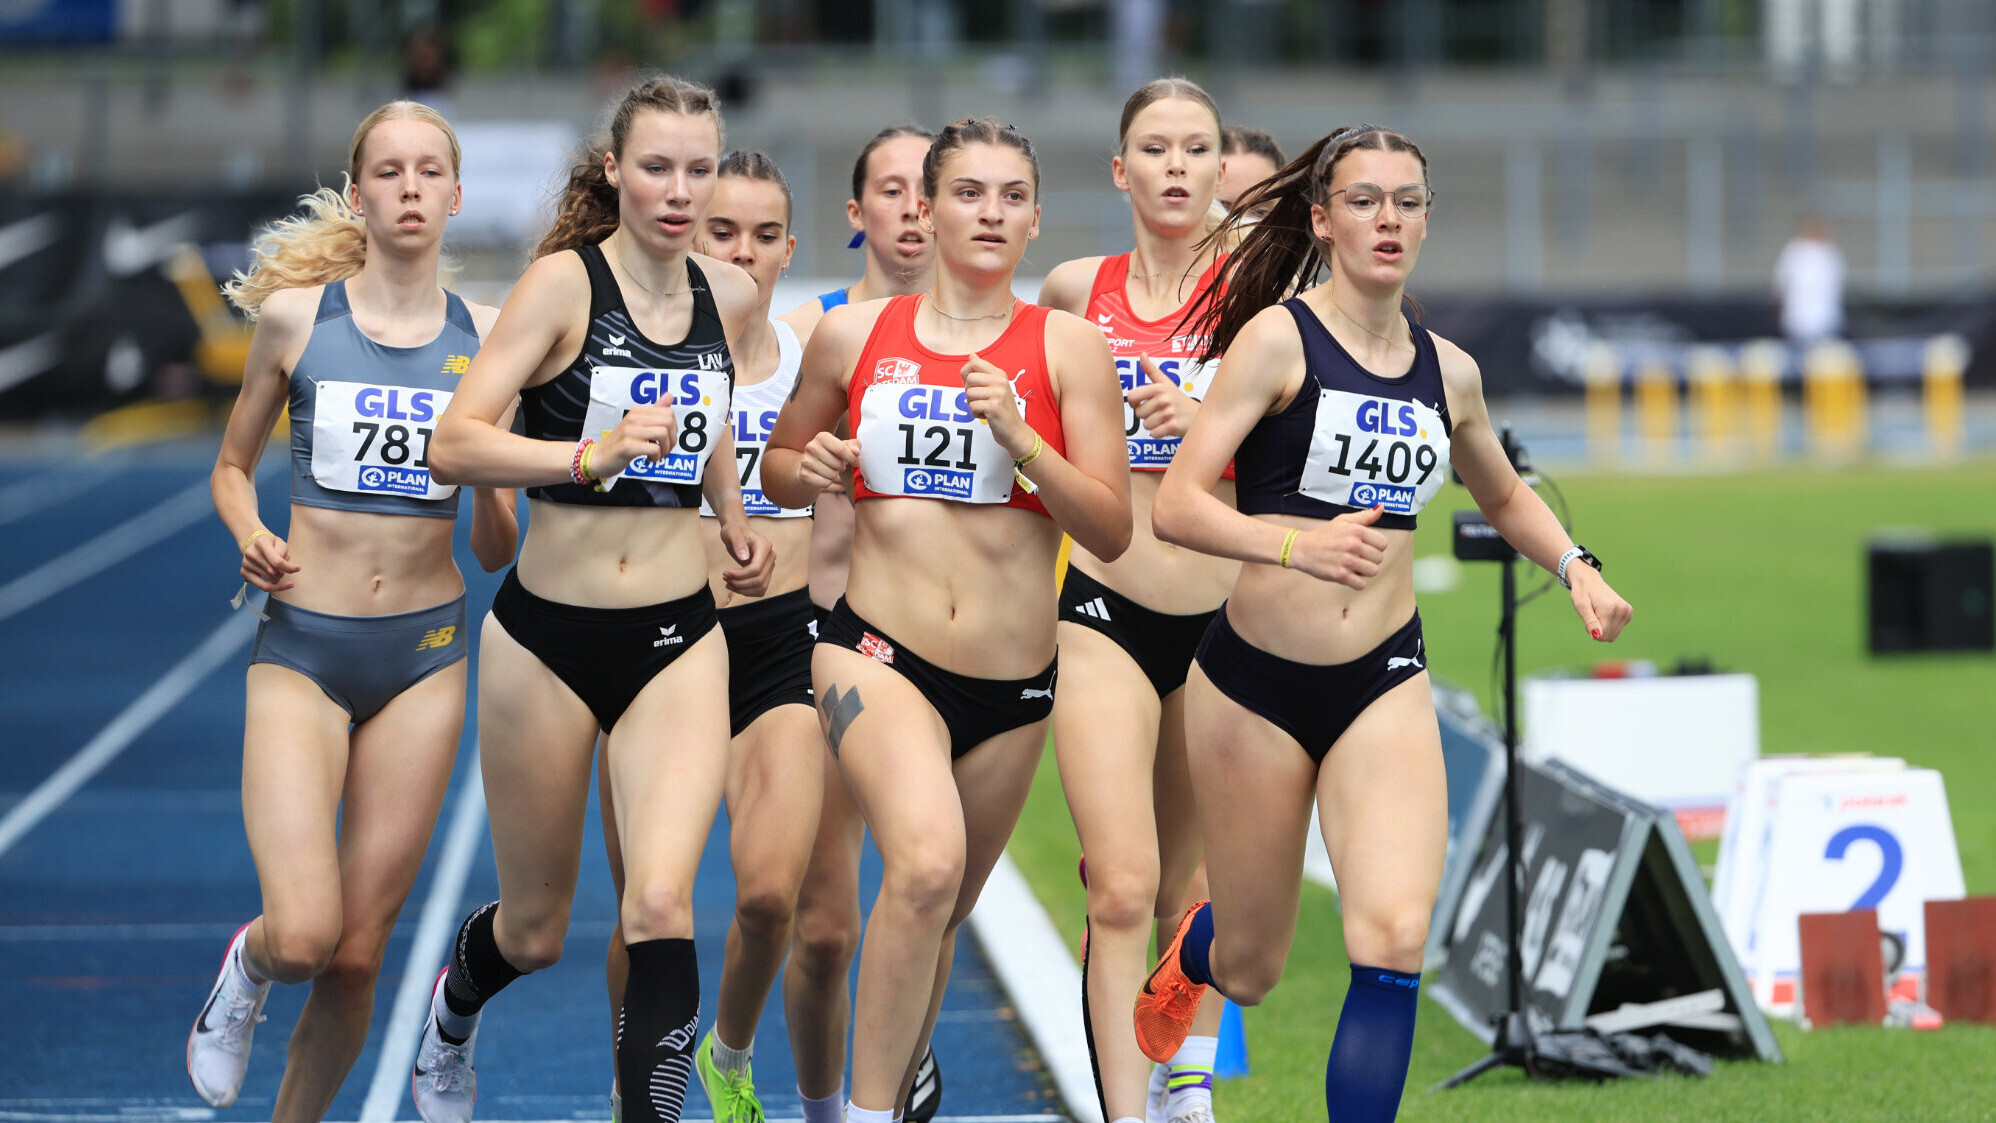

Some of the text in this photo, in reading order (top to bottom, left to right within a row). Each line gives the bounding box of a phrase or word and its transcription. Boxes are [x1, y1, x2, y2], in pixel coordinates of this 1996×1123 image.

[602, 347, 632, 357] erima
[877, 365, 894, 379] SC
[352, 421, 433, 468] 781
[897, 423, 977, 471] 121
[655, 457, 695, 472] PLAN
[1328, 433, 1437, 486] 1409
[387, 471, 427, 486] PLAN
[654, 469, 693, 478] INTERNATIONAL
[386, 483, 425, 493] INTERNATIONAL
[934, 473, 971, 489] PLAN
[934, 486, 969, 496] INTERNATIONAL
[1377, 488, 1413, 503] PLAN
[742, 493, 773, 505] PLA
[653, 635, 684, 648] erima
